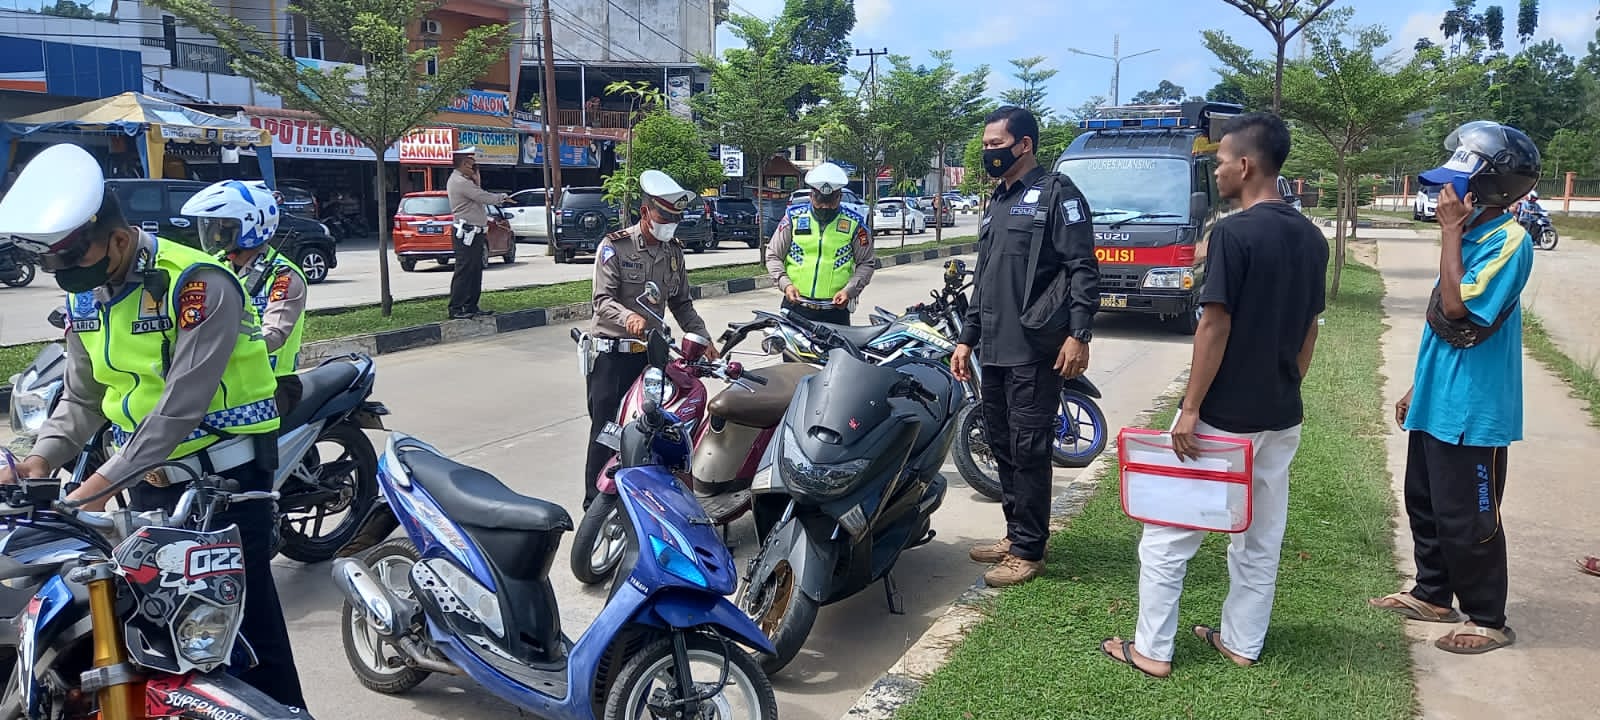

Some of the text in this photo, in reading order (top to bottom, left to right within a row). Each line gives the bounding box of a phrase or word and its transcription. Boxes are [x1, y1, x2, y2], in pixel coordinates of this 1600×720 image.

[472, 94, 504, 112] SALON
[402, 129, 450, 144] APOTEK
[481, 133, 517, 146] COSMETIC
[402, 145, 452, 158] SAKINAH
[1013, 207, 1037, 215] POLIS
[1095, 232, 1130, 241] SUZU
[1095, 248, 1135, 262] OLISI
[134, 320, 170, 332] POLRI
[1478, 480, 1490, 513] YONEX
[189, 547, 243, 577] 022
